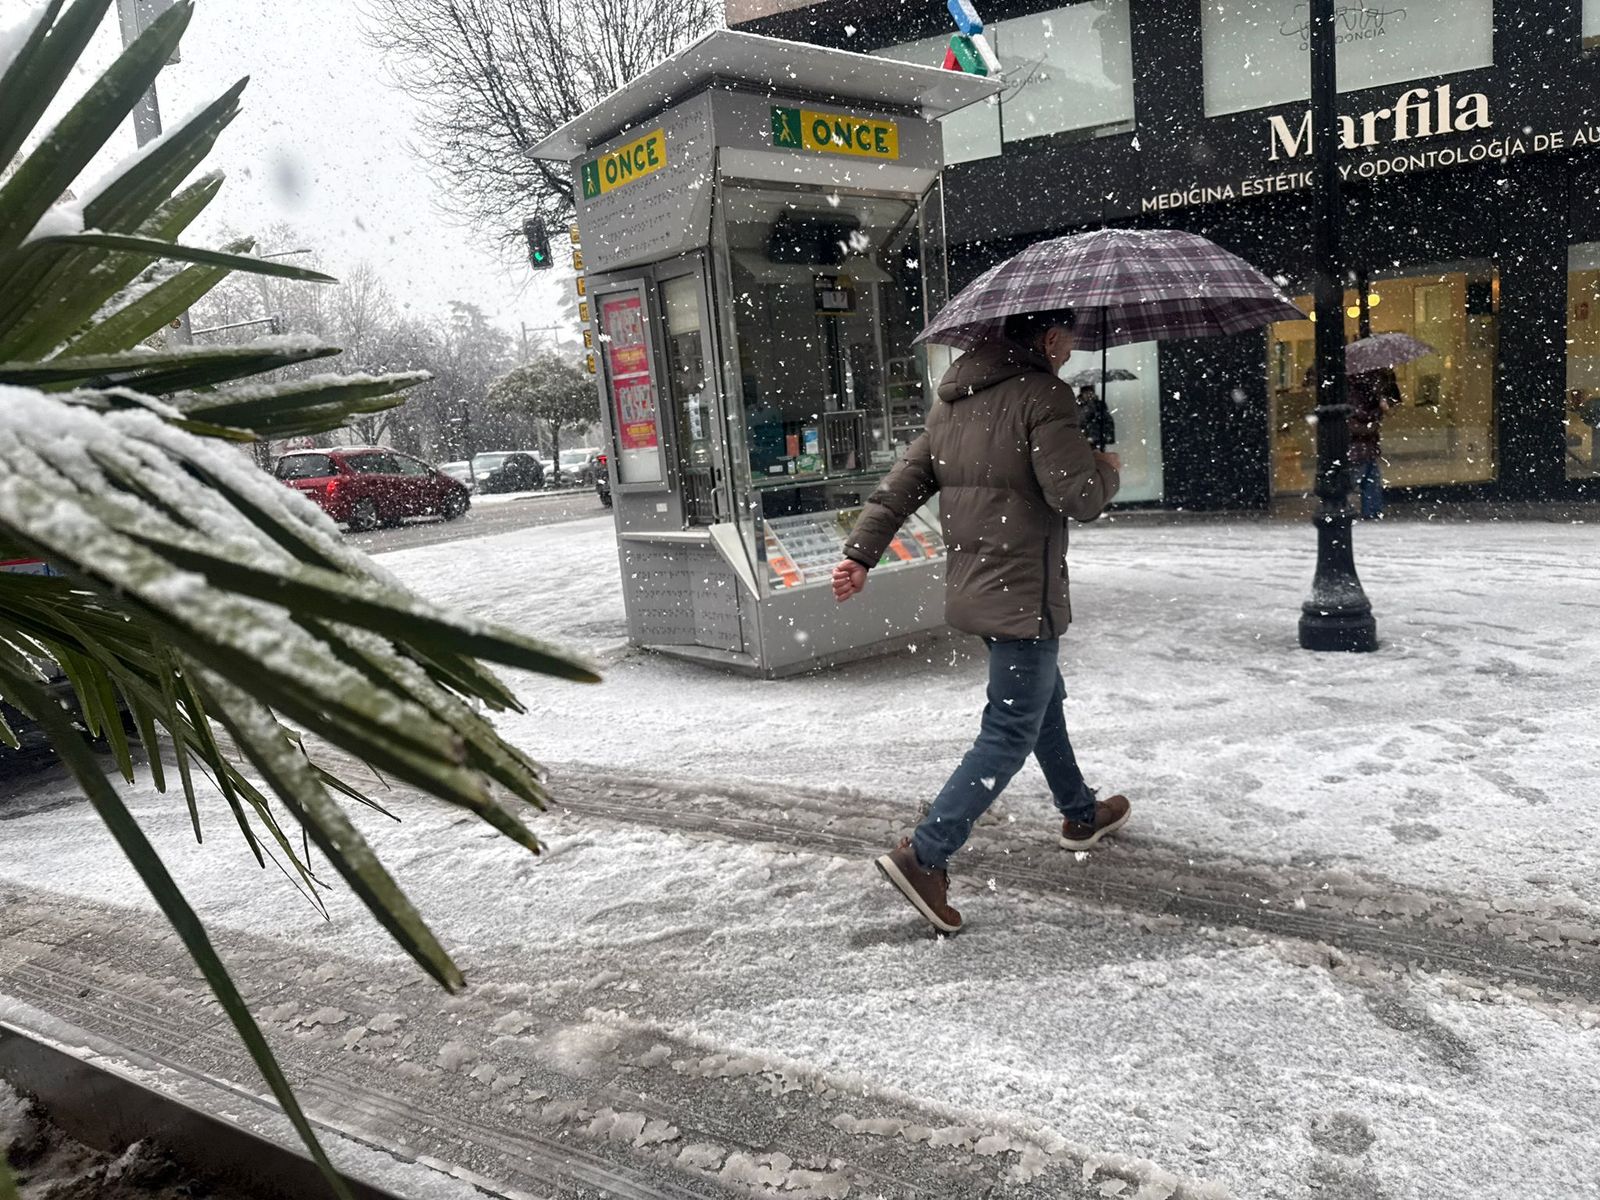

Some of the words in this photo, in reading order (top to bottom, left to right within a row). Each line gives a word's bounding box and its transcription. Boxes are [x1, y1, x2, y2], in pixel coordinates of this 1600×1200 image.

[1299, 27, 1386, 51] ODONCIA
[812, 119, 890, 153] ONCE
[1267, 83, 1494, 161] Marfila
[605, 137, 659, 184] ONCE
[1141, 184, 1235, 212] MEDICINA
[1241, 171, 1314, 197] ESTÉTIC
[1338, 164, 1352, 181] Y
[1358, 136, 1525, 178] ODONTOLOGÍA
[1534, 130, 1564, 151] DE
